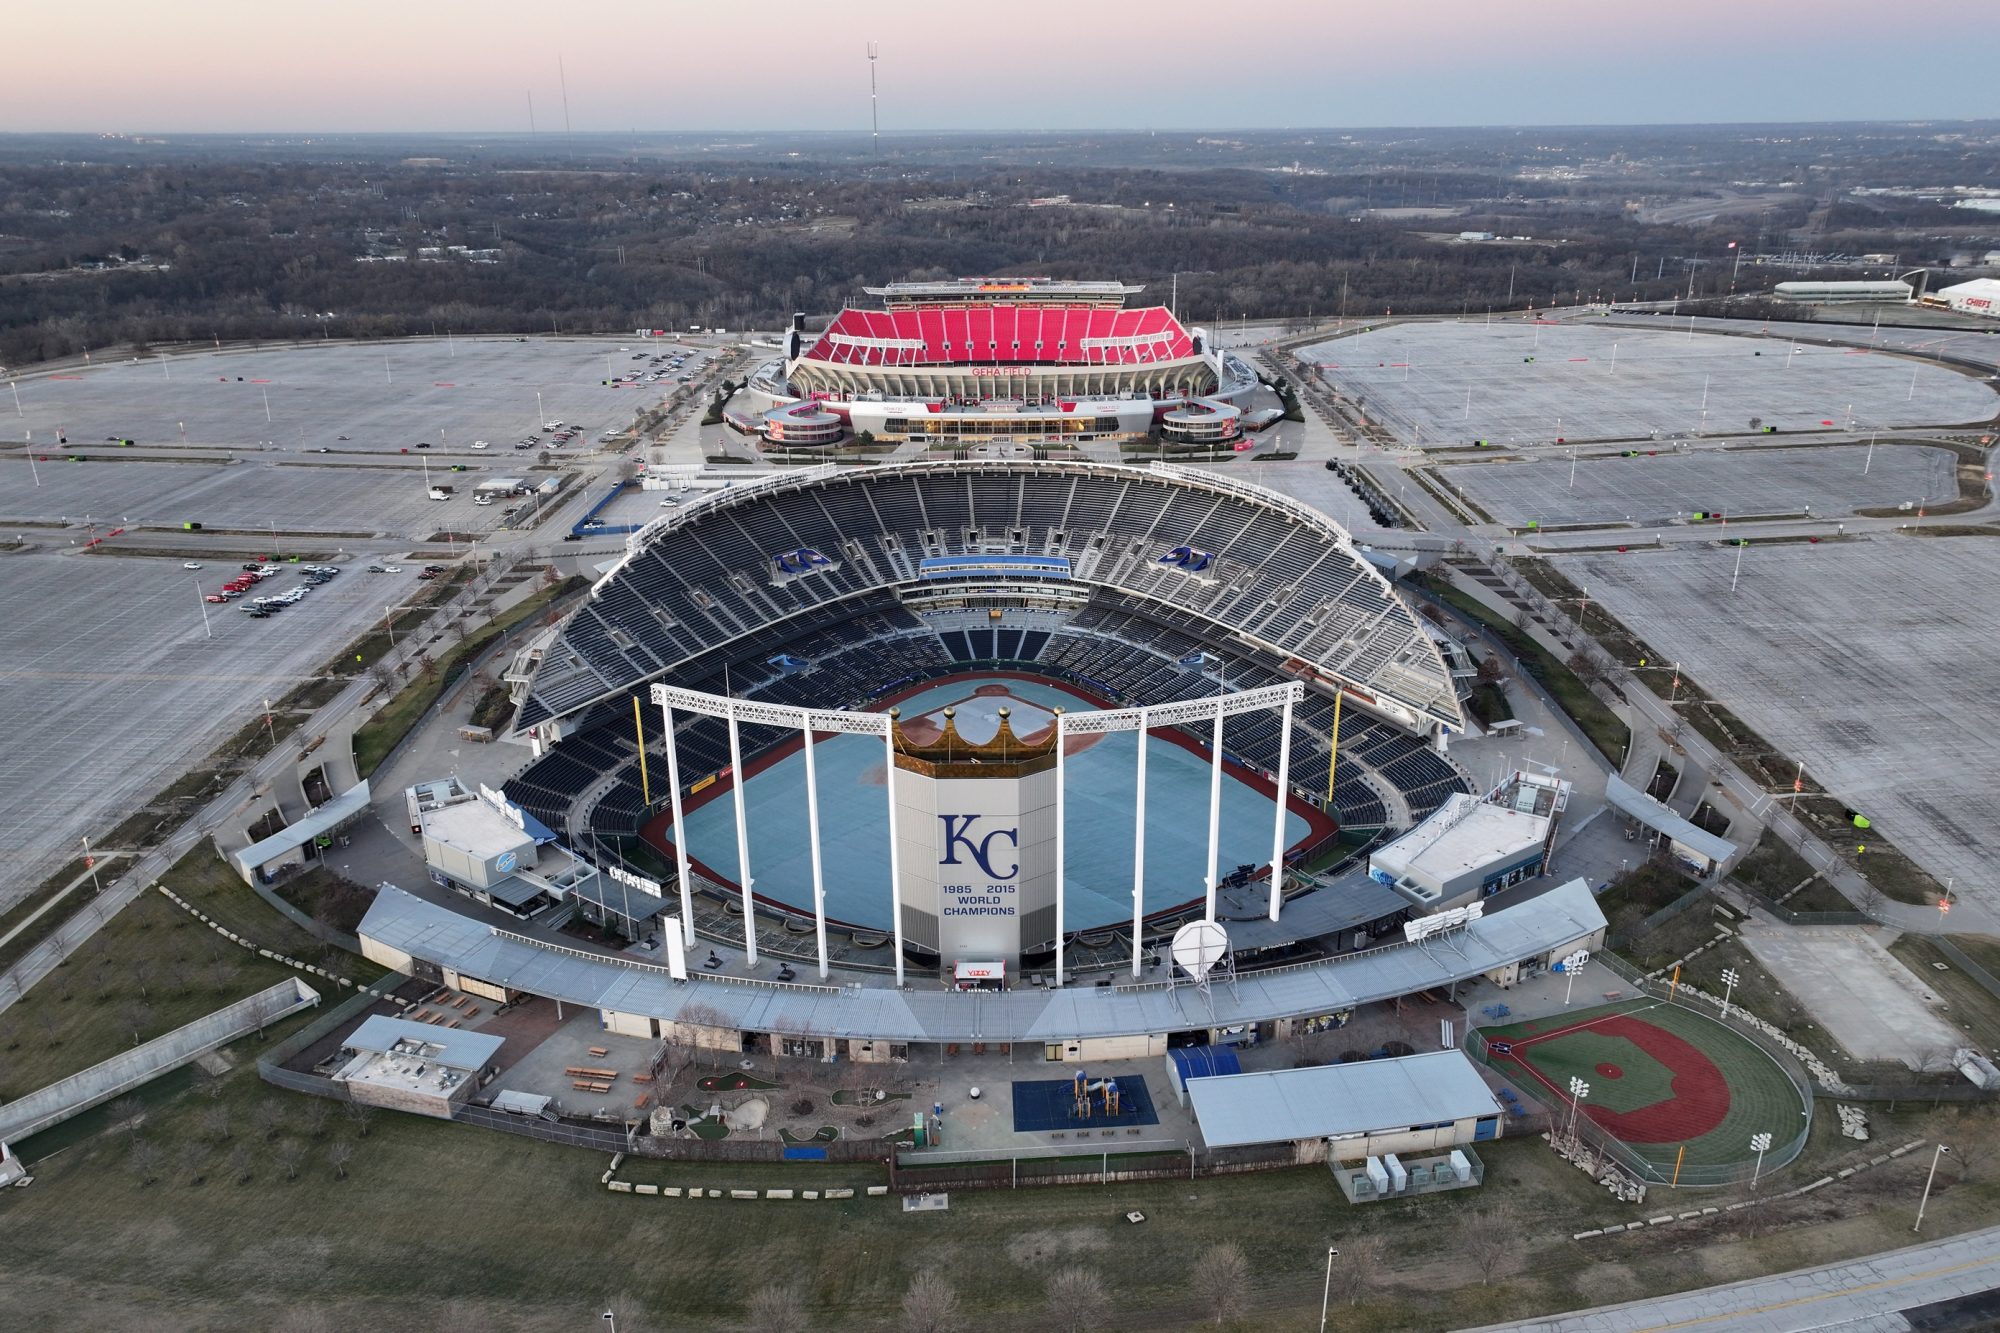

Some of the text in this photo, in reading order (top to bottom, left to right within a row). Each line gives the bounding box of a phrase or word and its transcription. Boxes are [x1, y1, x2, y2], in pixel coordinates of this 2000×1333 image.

[1966, 297, 1991, 308] CHIEFS
[972, 367, 1032, 376] GEHA FIELD
[938, 814, 1019, 880] KC
[943, 885, 1016, 894] 1985 2015
[957, 896, 1001, 905] WORLD
[943, 907, 1015, 916] CHAMPIONS
